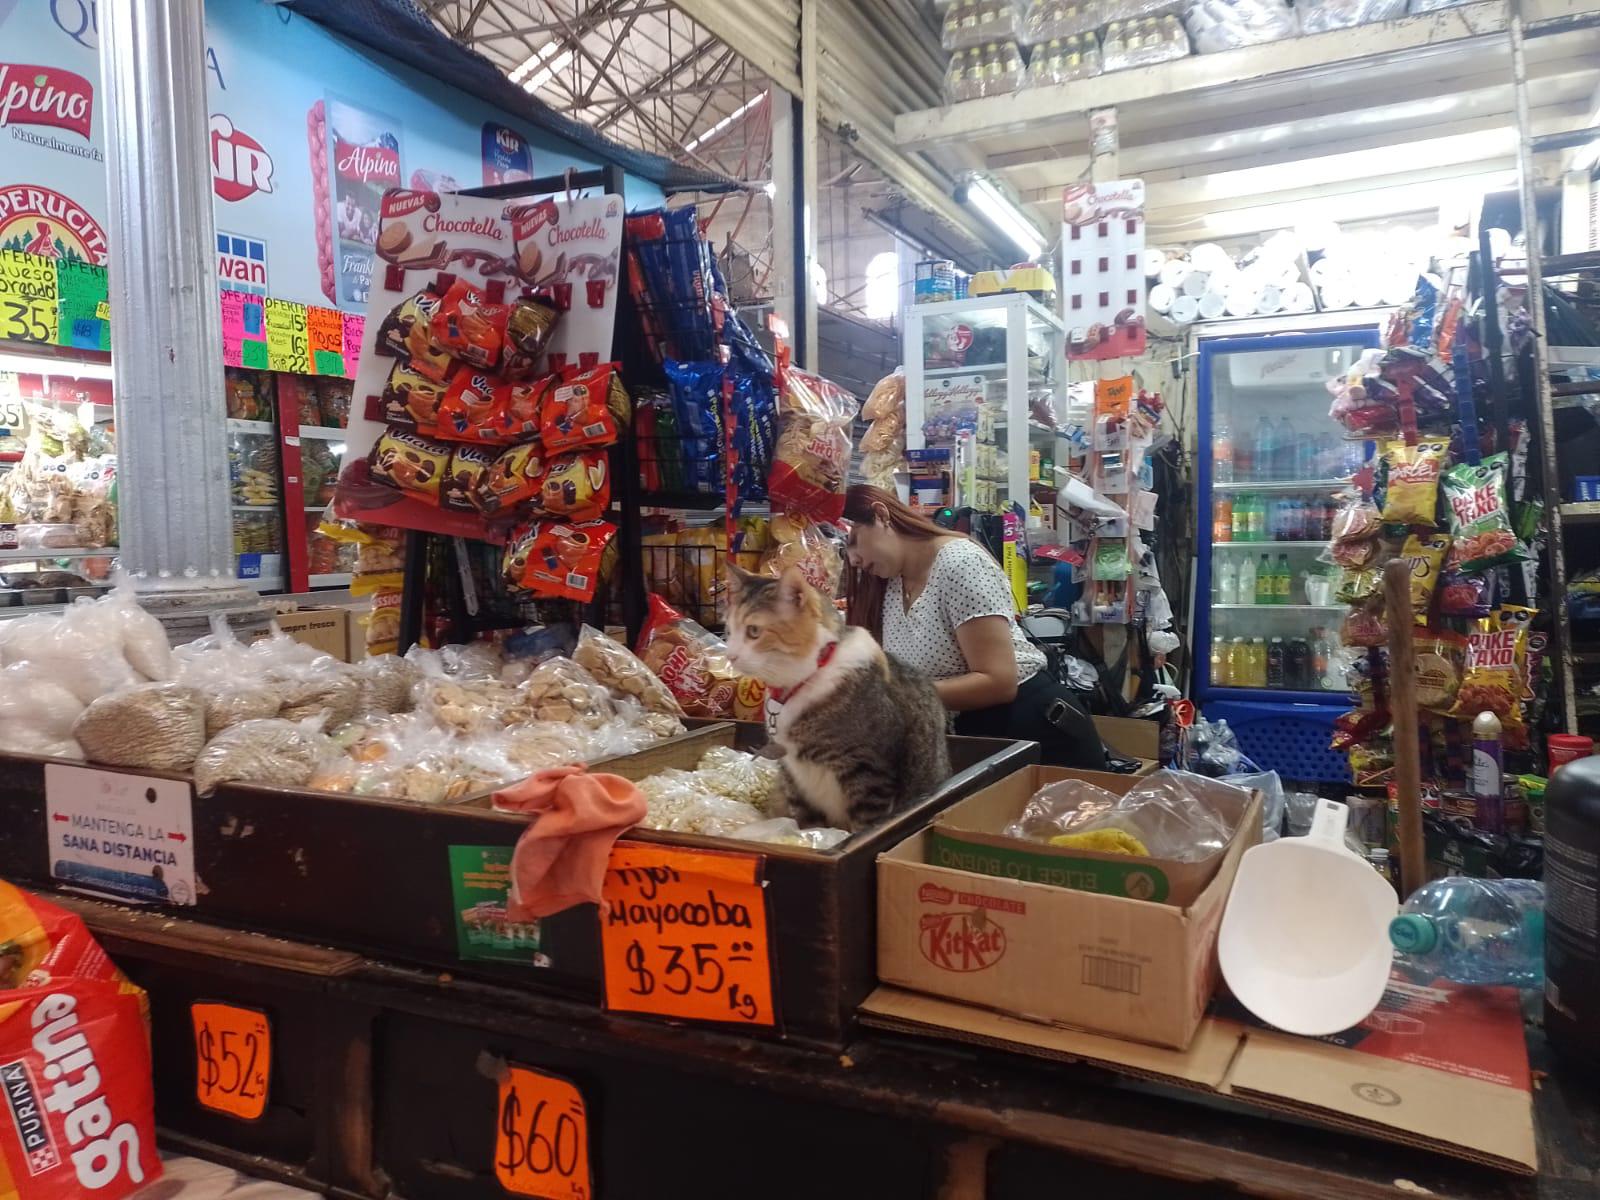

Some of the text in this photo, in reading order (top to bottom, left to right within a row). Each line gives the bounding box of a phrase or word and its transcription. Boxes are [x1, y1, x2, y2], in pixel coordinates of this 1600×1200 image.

[338, 147, 397, 182] Alpino
[389, 194, 504, 241] NUEVAS Chocotella
[520, 208, 606, 247] NUEVAS Chocotella
[4, 301, 50, 342] 35
[242, 567, 260, 576] VISA
[71, 813, 165, 842] MANTENGA LA
[63, 833, 178, 867] SANA DISTANCIA
[7, 1065, 46, 1148] PURINA
